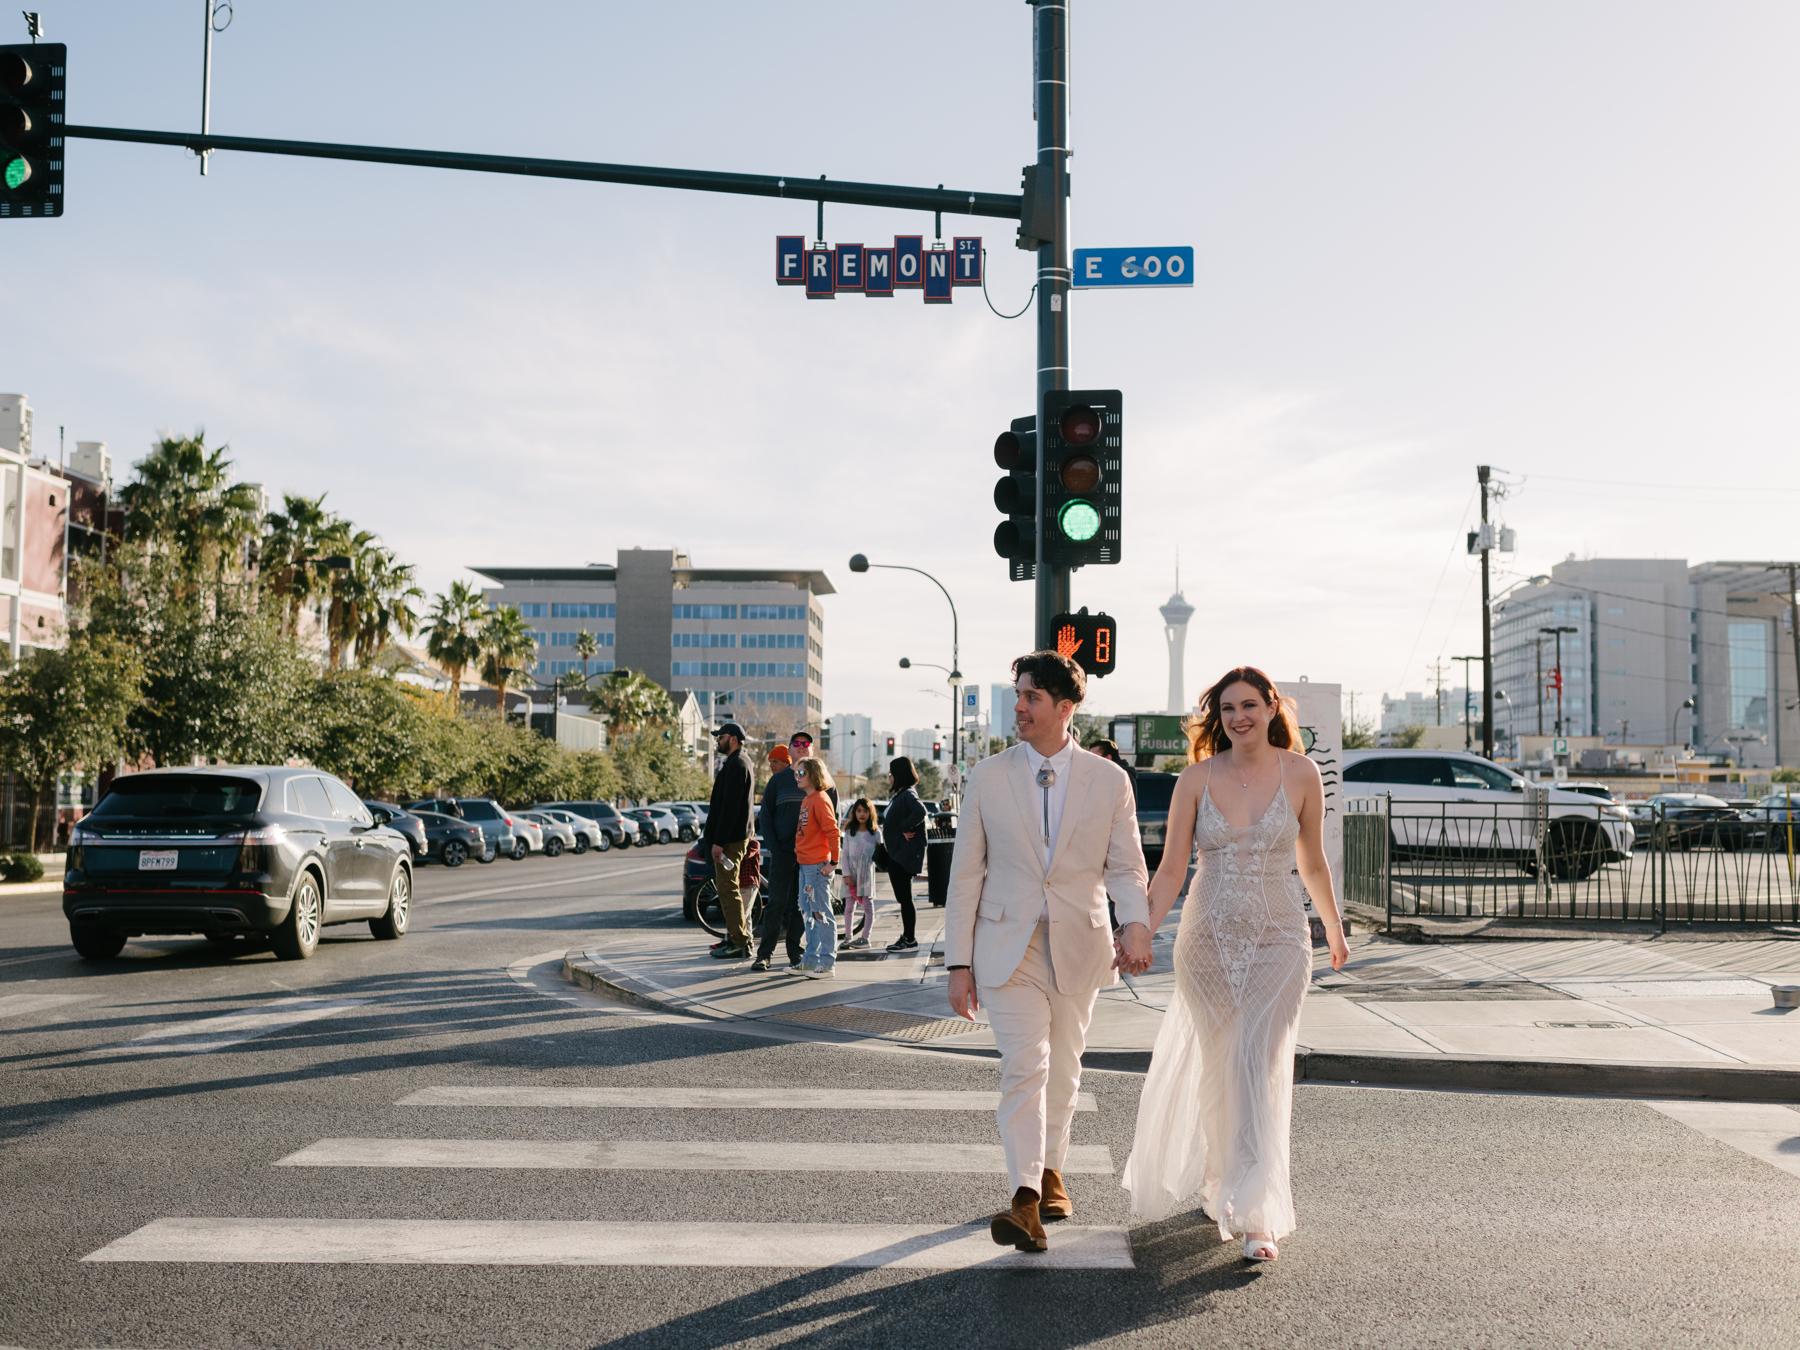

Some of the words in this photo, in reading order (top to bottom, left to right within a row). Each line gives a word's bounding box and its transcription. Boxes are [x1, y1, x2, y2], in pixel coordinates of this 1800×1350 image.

[959, 240, 976, 250] ST.
[783, 253, 975, 277] FREMONT
[1086, 256, 1103, 279] E
[1121, 255, 1185, 278] 600
[1140, 739, 1179, 750] PUBLIC
